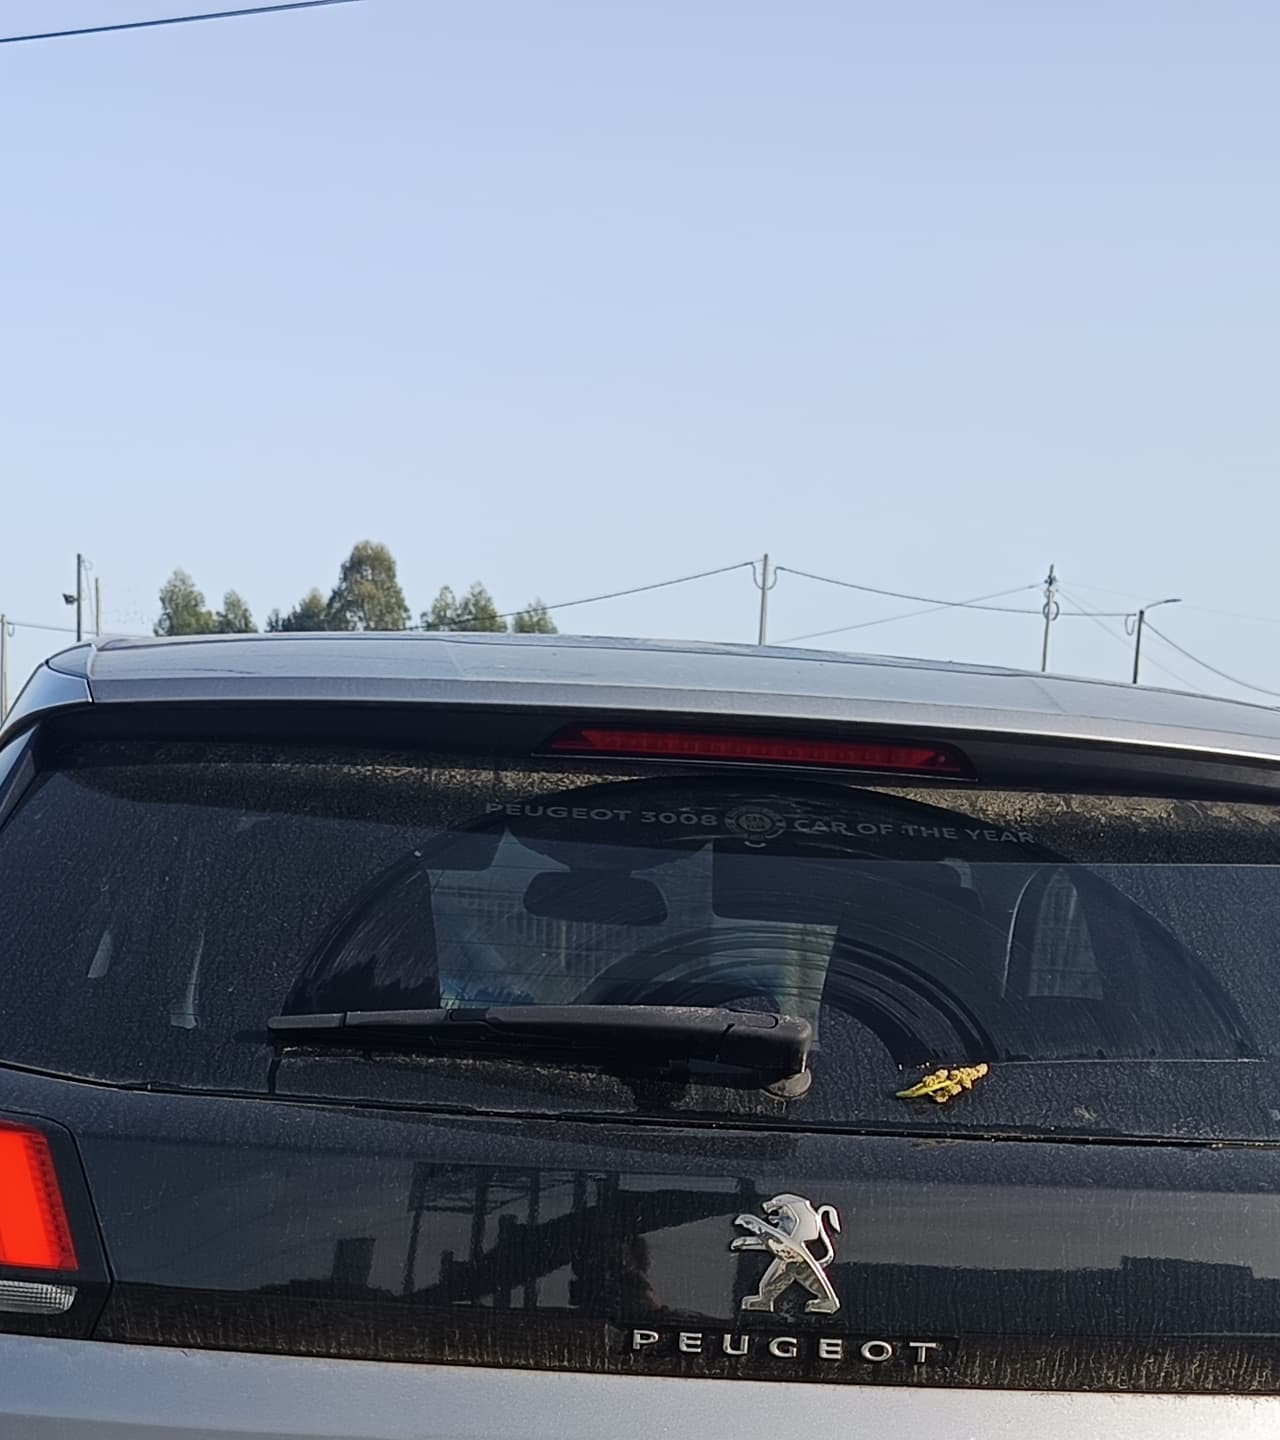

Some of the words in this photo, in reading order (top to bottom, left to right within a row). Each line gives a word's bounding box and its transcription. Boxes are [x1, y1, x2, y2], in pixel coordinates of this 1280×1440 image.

[484, 802, 632, 822] PEUGEOT
[640, 810, 718, 826] 3008
[793, 818, 850, 835] CAR
[857, 822, 894, 836] OF
[902, 824, 959, 840] THE
[964, 828, 1036, 845] YEAR
[632, 1329, 939, 1363] PEUGEOT
